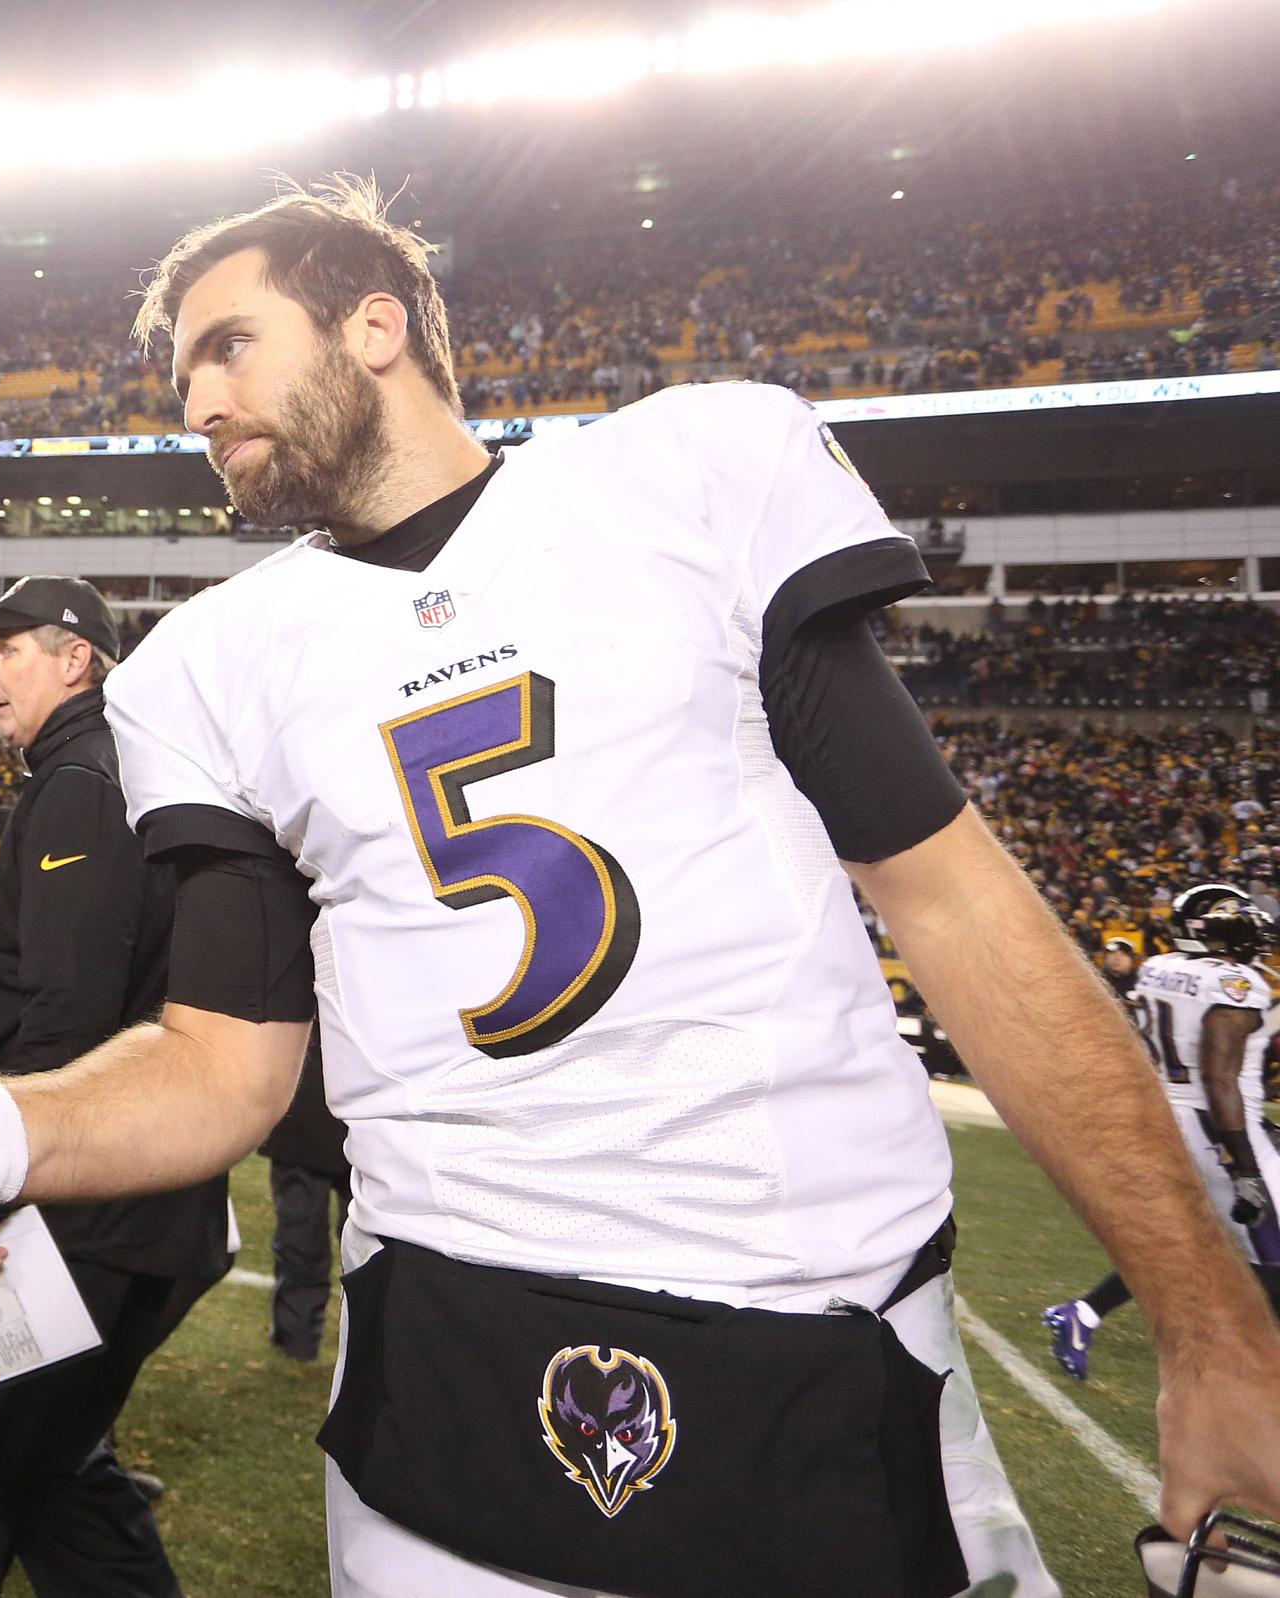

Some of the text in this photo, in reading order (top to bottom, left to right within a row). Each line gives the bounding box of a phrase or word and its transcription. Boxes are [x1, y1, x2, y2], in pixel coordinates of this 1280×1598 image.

[1029, 389, 1073, 406] WIN
[1095, 385, 1139, 401] YOU
[1153, 381, 1201, 397] WIN
[420, 604, 453, 625] NFL
[398, 644, 518, 698] RAVENS
[377, 670, 641, 1060] 5
